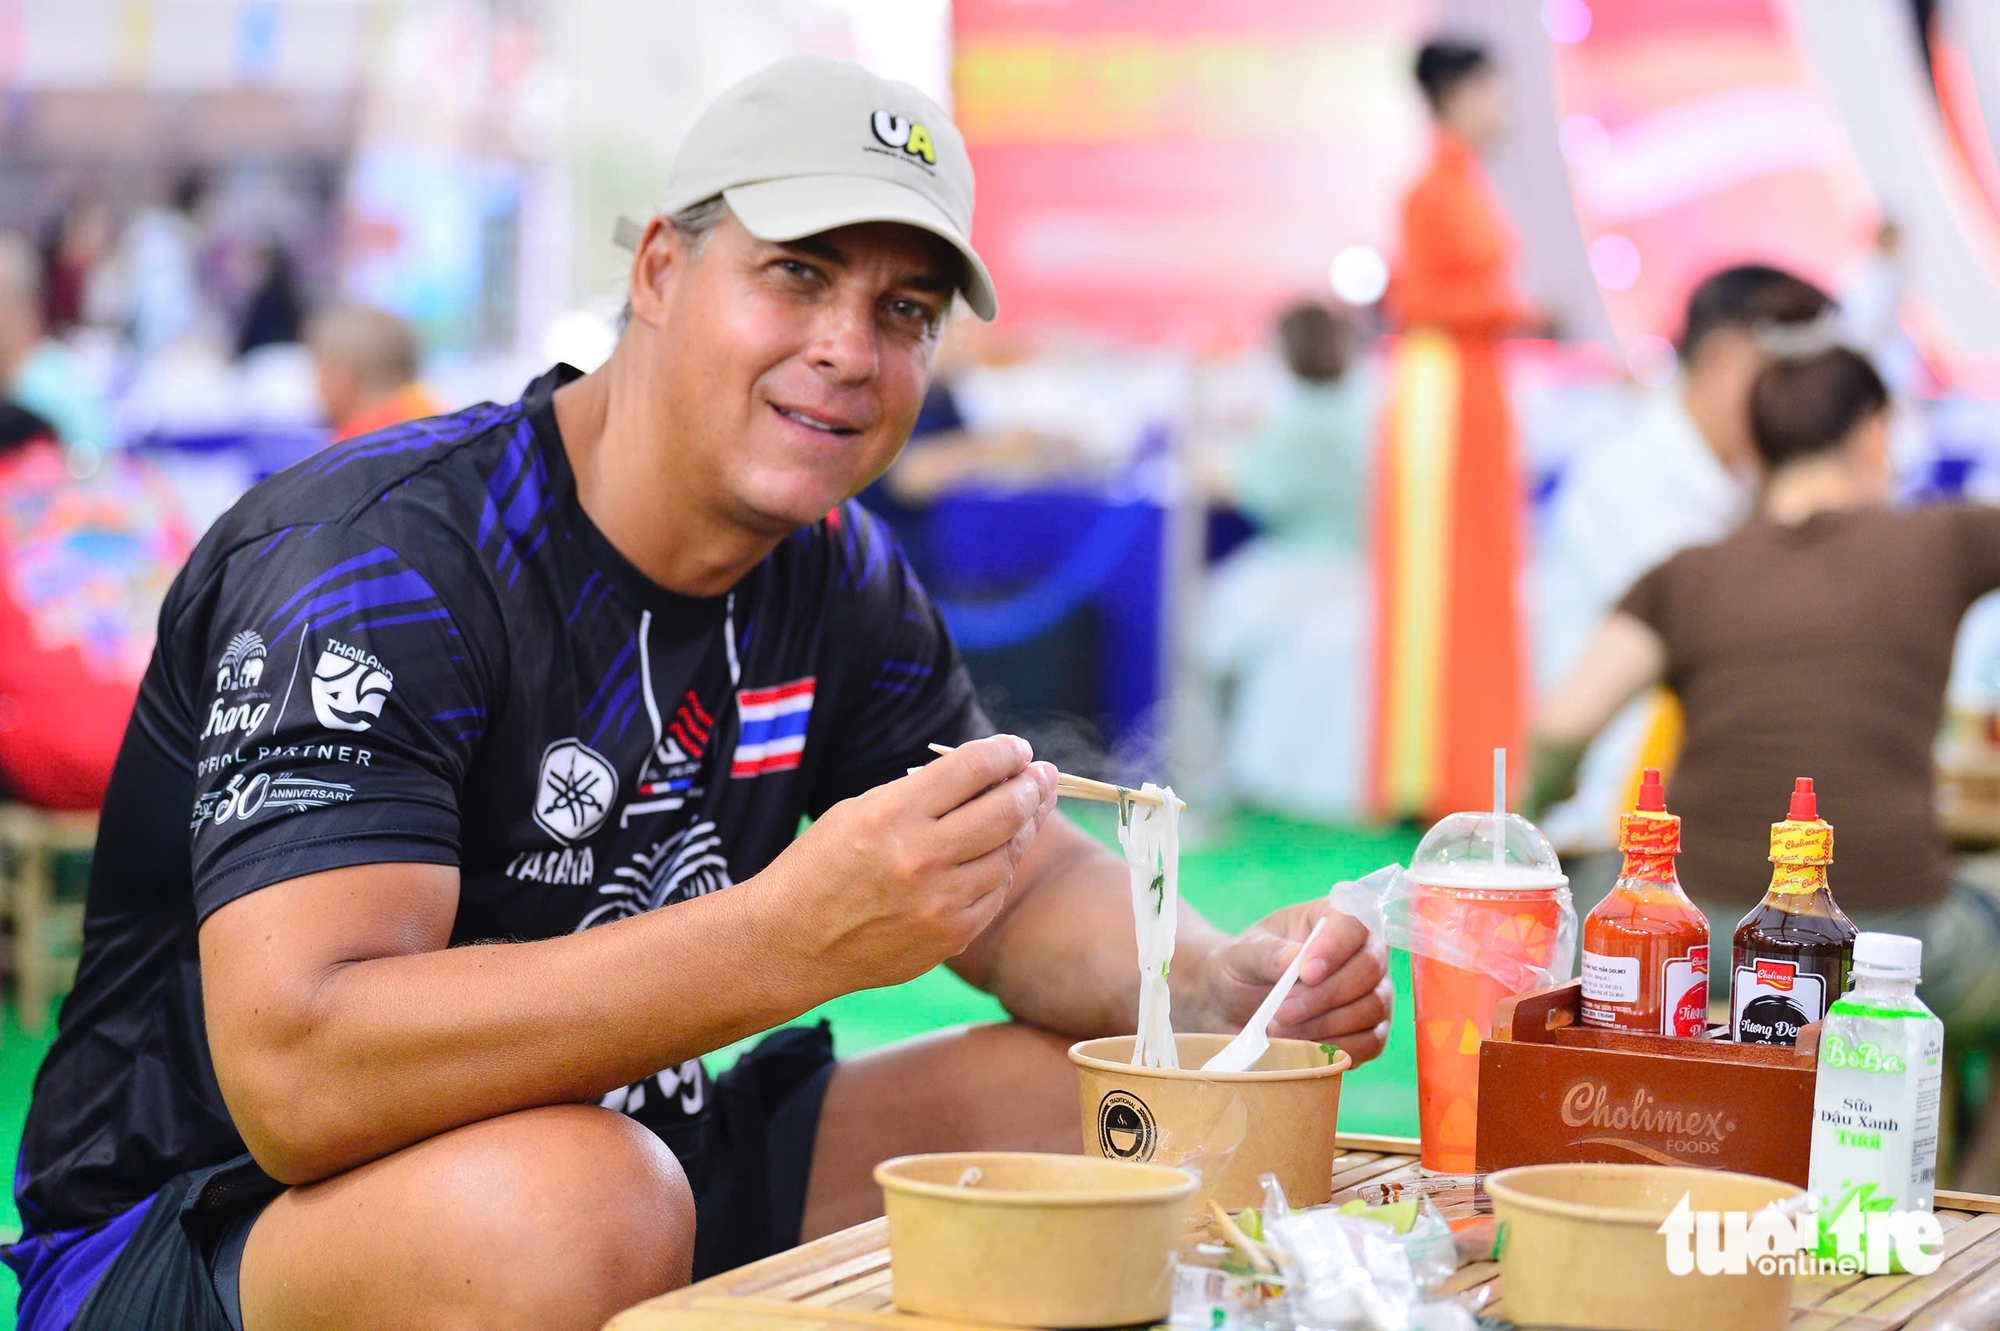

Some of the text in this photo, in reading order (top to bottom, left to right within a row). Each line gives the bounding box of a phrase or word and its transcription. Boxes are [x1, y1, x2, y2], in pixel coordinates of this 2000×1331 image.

[871, 110, 936, 165] UA
[326, 638, 394, 682] THAILAND
[200, 698, 271, 741] hang
[269, 788, 354, 802] ANNIVERSARY
[1785, 839, 1820, 850] Cholimex
[1757, 969, 1795, 982] Cholimex
[1741, 1019, 1773, 1040] Tương
[1825, 1034, 1906, 1075] BoBa
[1109, 1096, 1136, 1110] TRADITIONAL
[1560, 1081, 1727, 1141] Cholimex
[1842, 1097, 1873, 1113] Sữa
[1821, 1109, 1852, 1127] Đậu
[1857, 1114, 1899, 1132] Xanh
[1666, 1139, 1720, 1154] FOODS
[1835, 1129, 1882, 1151] Tươi
